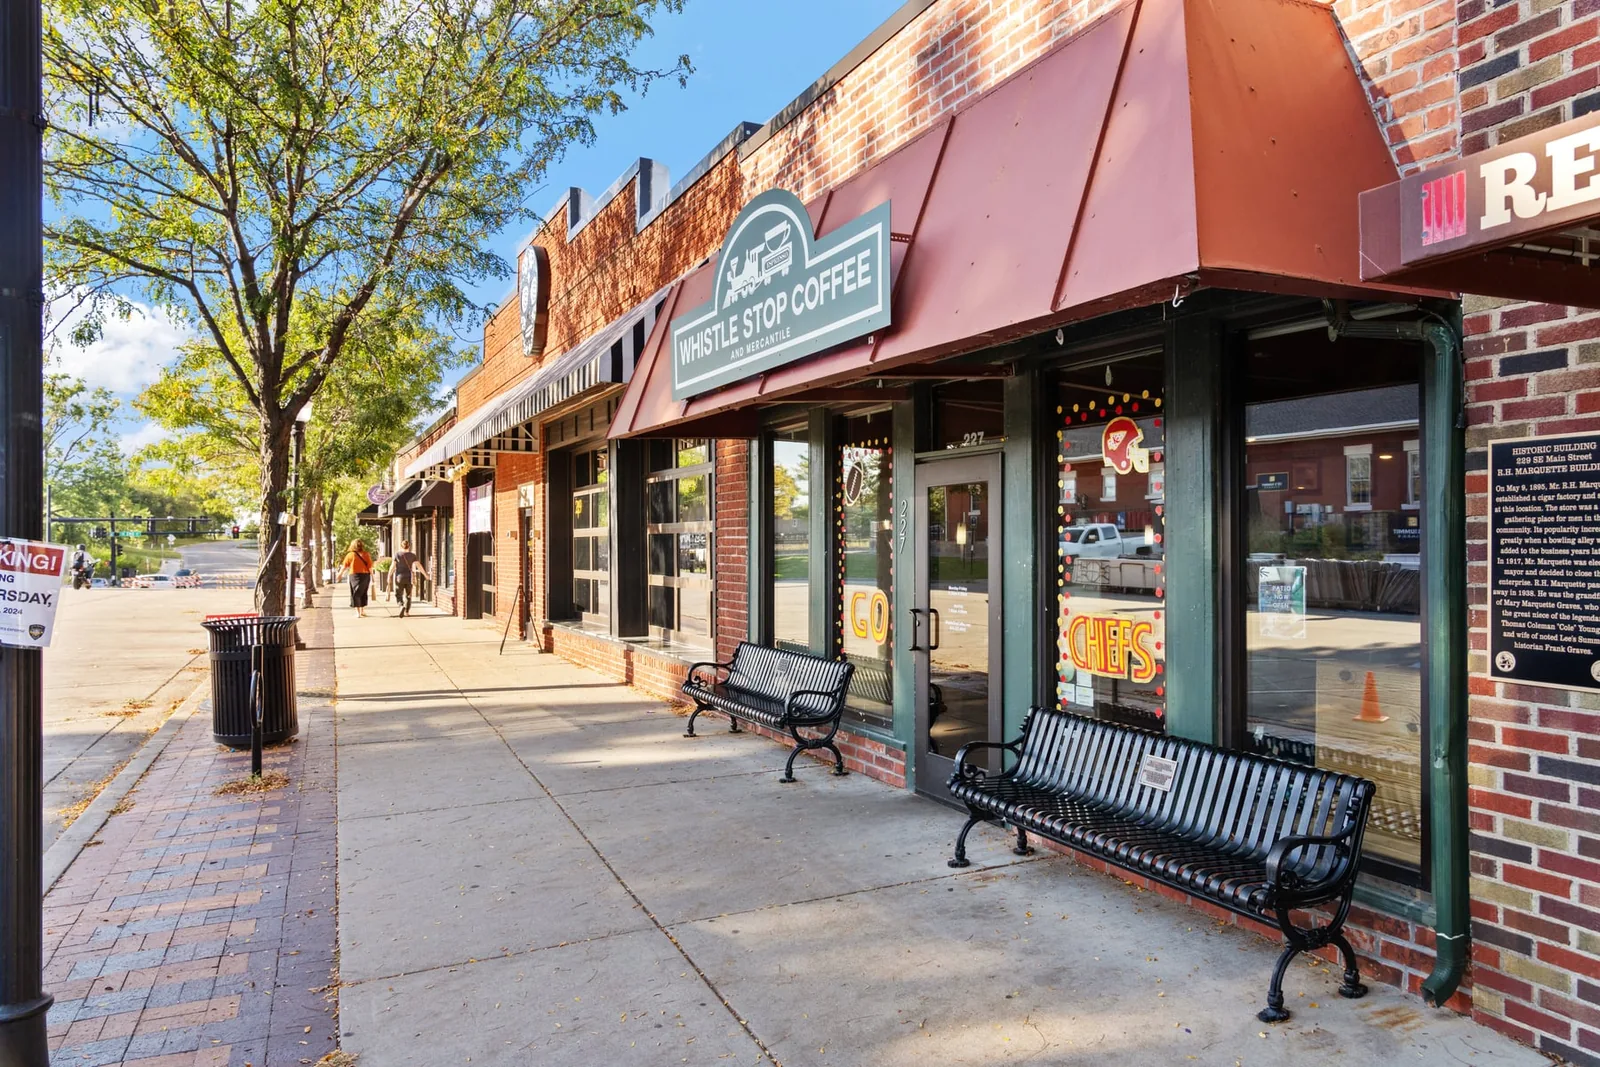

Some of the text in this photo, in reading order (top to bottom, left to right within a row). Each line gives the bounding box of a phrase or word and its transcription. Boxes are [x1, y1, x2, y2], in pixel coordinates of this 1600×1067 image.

[680, 248, 872, 366] WHISTLE STOP COFFEE
[730, 327, 790, 360] AND MERCANTILE
[964, 431, 984, 446] 227
[1512, 442, 1596, 455] HISTORIC BUILDING
[1568, 453, 1592, 461] Street
[1515, 465, 1568, 476] MARQUETTE
[1506, 484, 1520, 493] May
[1496, 494, 1530, 502] established
[1538, 494, 1555, 502] cigar
[1557, 493, 1580, 501] factory
[1504, 516, 1536, 524] gathering
[1537, 516, 1555, 524] place
[900, 500, 908, 554] 227
[1544, 526, 1579, 534] popularity
[1501, 536, 1523, 545] greatly
[1549, 536, 1576, 545] bowling
[1577, 536, 1594, 545] alley
[1537, 558, 1572, 567] Marquette
[1499, 579, 1532, 587] enterprise.
[1550, 580, 1586, 589] Marquette
[1504, 599, 1520, 608] Mary
[1522, 600, 1555, 609] Marquette
[1557, 602, 1582, 610] Graves,
[851, 592, 888, 643] GO
[1527, 622, 1555, 630] Coleman
[1068, 615, 1154, 680] CHIEFS
[1514, 642, 1593, 655] historian Frank Graves.
